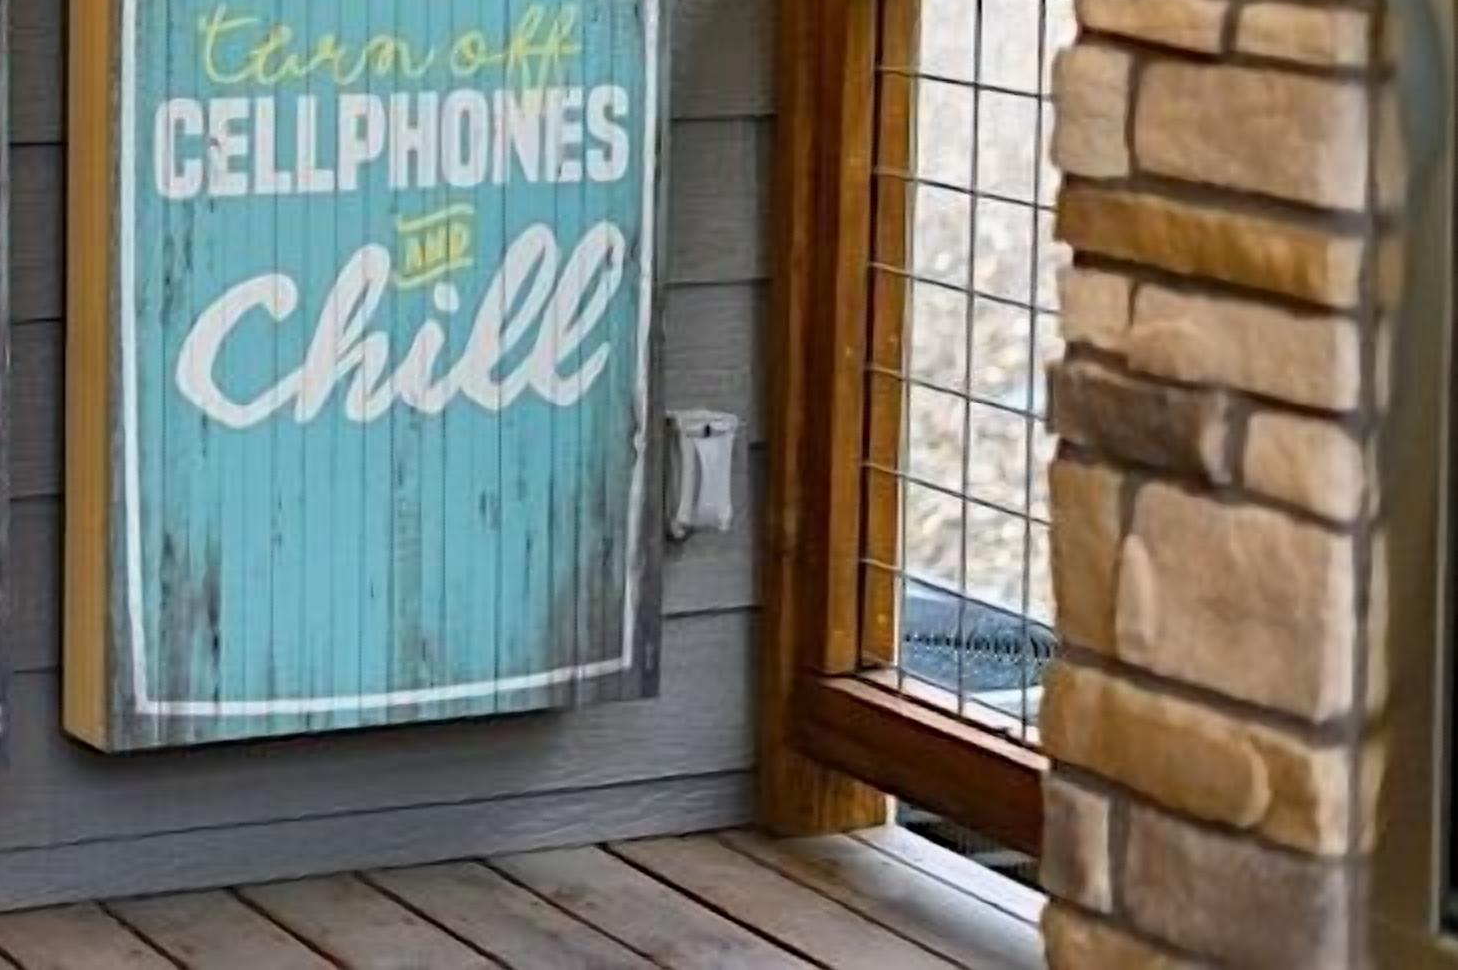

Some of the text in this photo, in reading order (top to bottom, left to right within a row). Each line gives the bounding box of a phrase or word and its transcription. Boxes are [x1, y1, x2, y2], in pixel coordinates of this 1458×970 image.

[200, 4, 581, 108] turn off
[154, 85, 630, 200] CELLPHONES
[405, 224, 470, 269] AND
[177, 221, 625, 429] Chill
